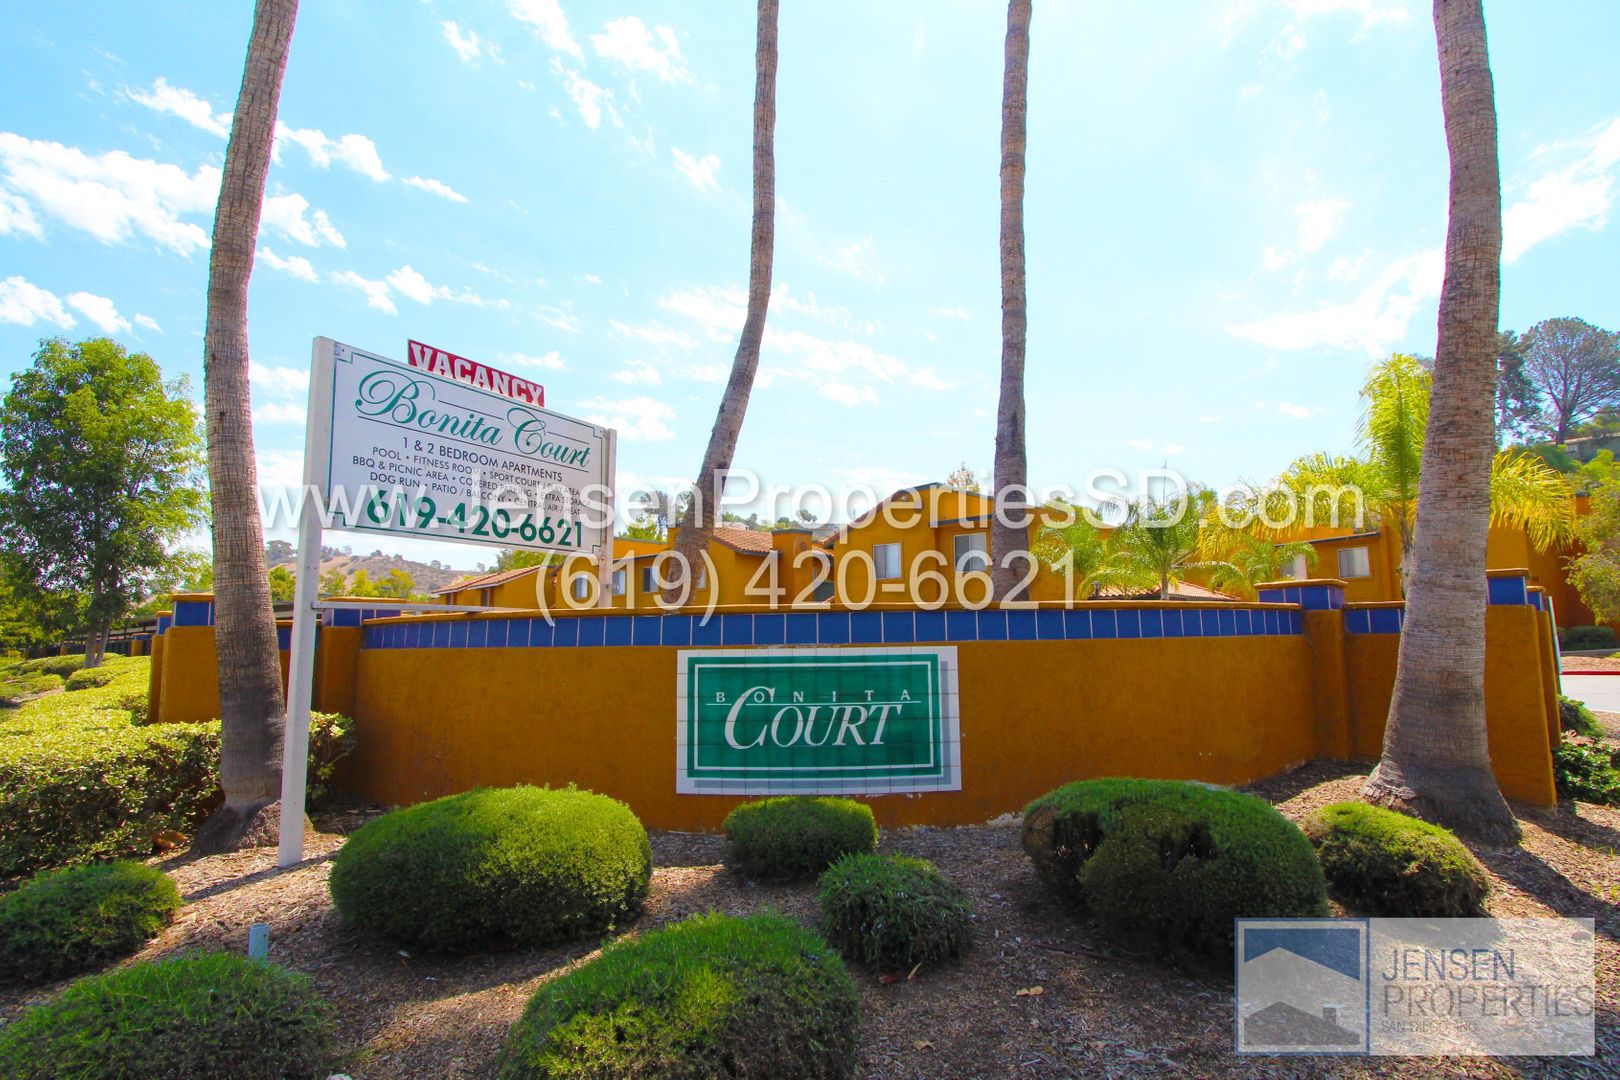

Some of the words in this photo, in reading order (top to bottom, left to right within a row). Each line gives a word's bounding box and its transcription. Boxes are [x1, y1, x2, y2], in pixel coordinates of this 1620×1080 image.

[410, 342, 544, 408] VACANCY
[355, 370, 503, 446] Bonita
[506, 407, 591, 468] Court
[352, 455, 375, 469] BBQ
[378, 460, 386, 470] &
[388, 463, 423, 477] PICNIC
[425, 470, 449, 481] AREA
[459, 476, 498, 491] COVERED
[540, 492, 561, 502] EXTRA
[372, 446, 402, 461] POOL
[413, 455, 450, 470] FITNESS
[452, 463, 480, 475] ROOM
[489, 471, 514, 483] SPORT
[515, 476, 541, 488] COURT
[403, 437, 408, 449] 1
[414, 440, 423, 452] &
[427, 443, 435, 454] 2
[439, 445, 499, 468] BEDROOM
[501, 460, 563, 482] APARTMENTS
[370, 471, 396, 484] DOG
[399, 477, 420, 488] RUN
[432, 483, 458, 495] PATIO
[547, 504, 558, 512] AIR
[366, 489, 582, 548] 619-420-6621
[715, 689, 911, 704] BONITA
